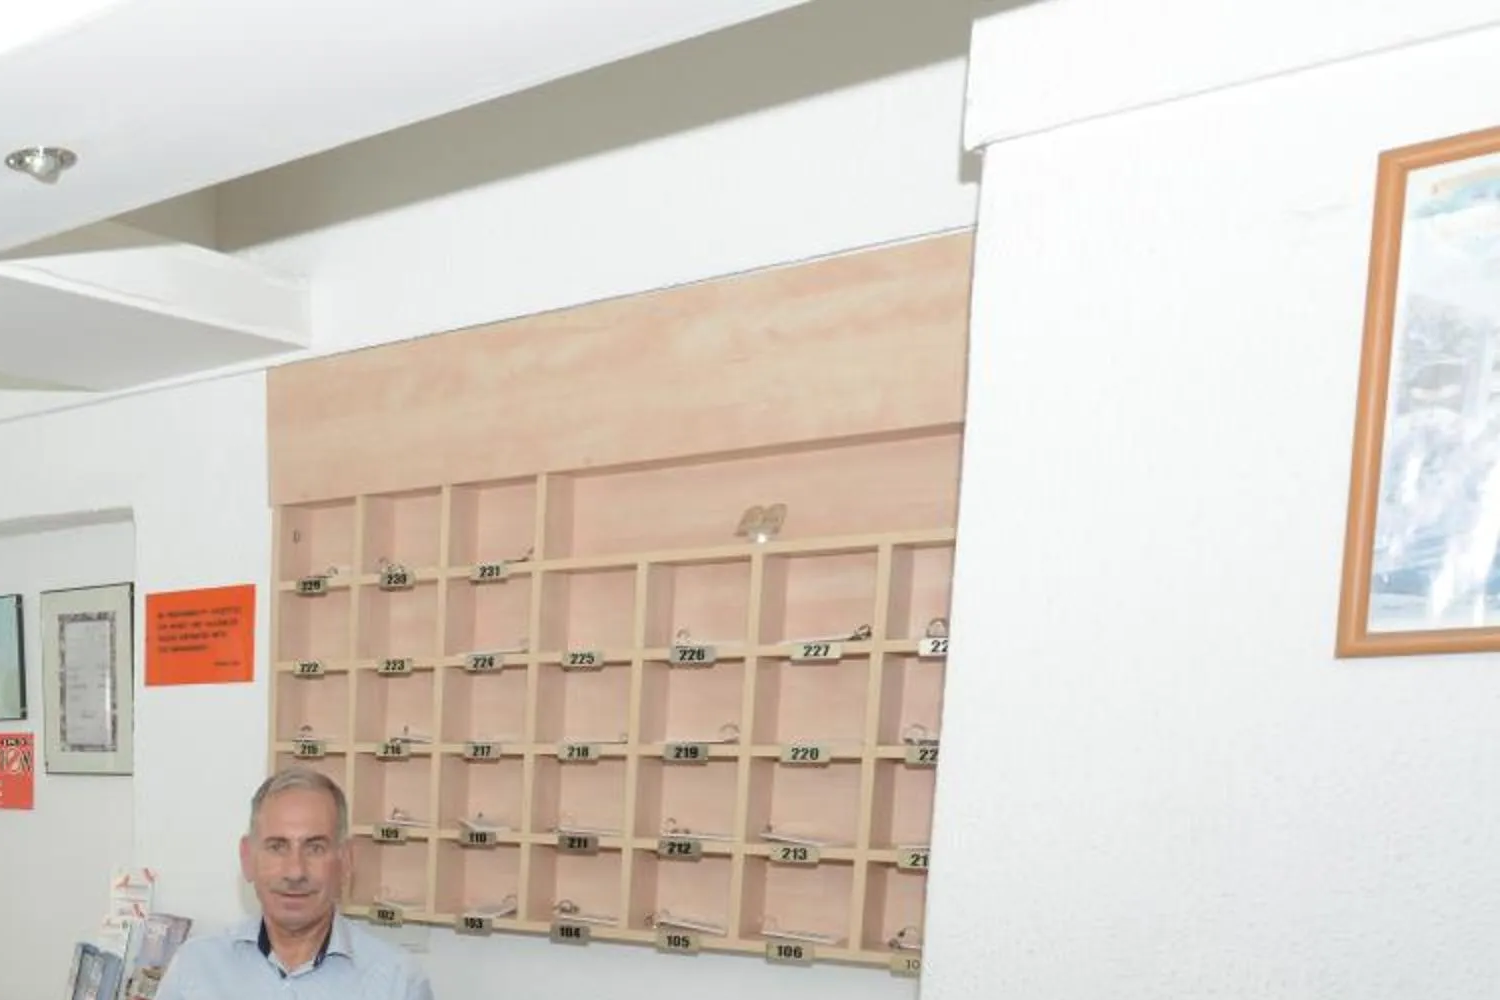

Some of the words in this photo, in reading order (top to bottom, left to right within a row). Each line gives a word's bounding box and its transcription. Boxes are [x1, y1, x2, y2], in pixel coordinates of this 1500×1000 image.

[479, 566, 500, 577] 231
[803, 643, 830, 656] 227
[931, 638, 949, 653] 22
[570, 653, 595, 665] 225
[472, 744, 492, 757] 217
[567, 745, 590, 758] 218
[674, 746, 698, 759] 219
[791, 747, 819, 761] 220
[919, 748, 938, 762] 22
[667, 842, 692, 855] 212
[781, 847, 808, 861] 213
[910, 853, 928, 868] 21
[666, 935, 691, 948] 105
[776, 945, 804, 958] 106
[904, 958, 921, 971] 10
